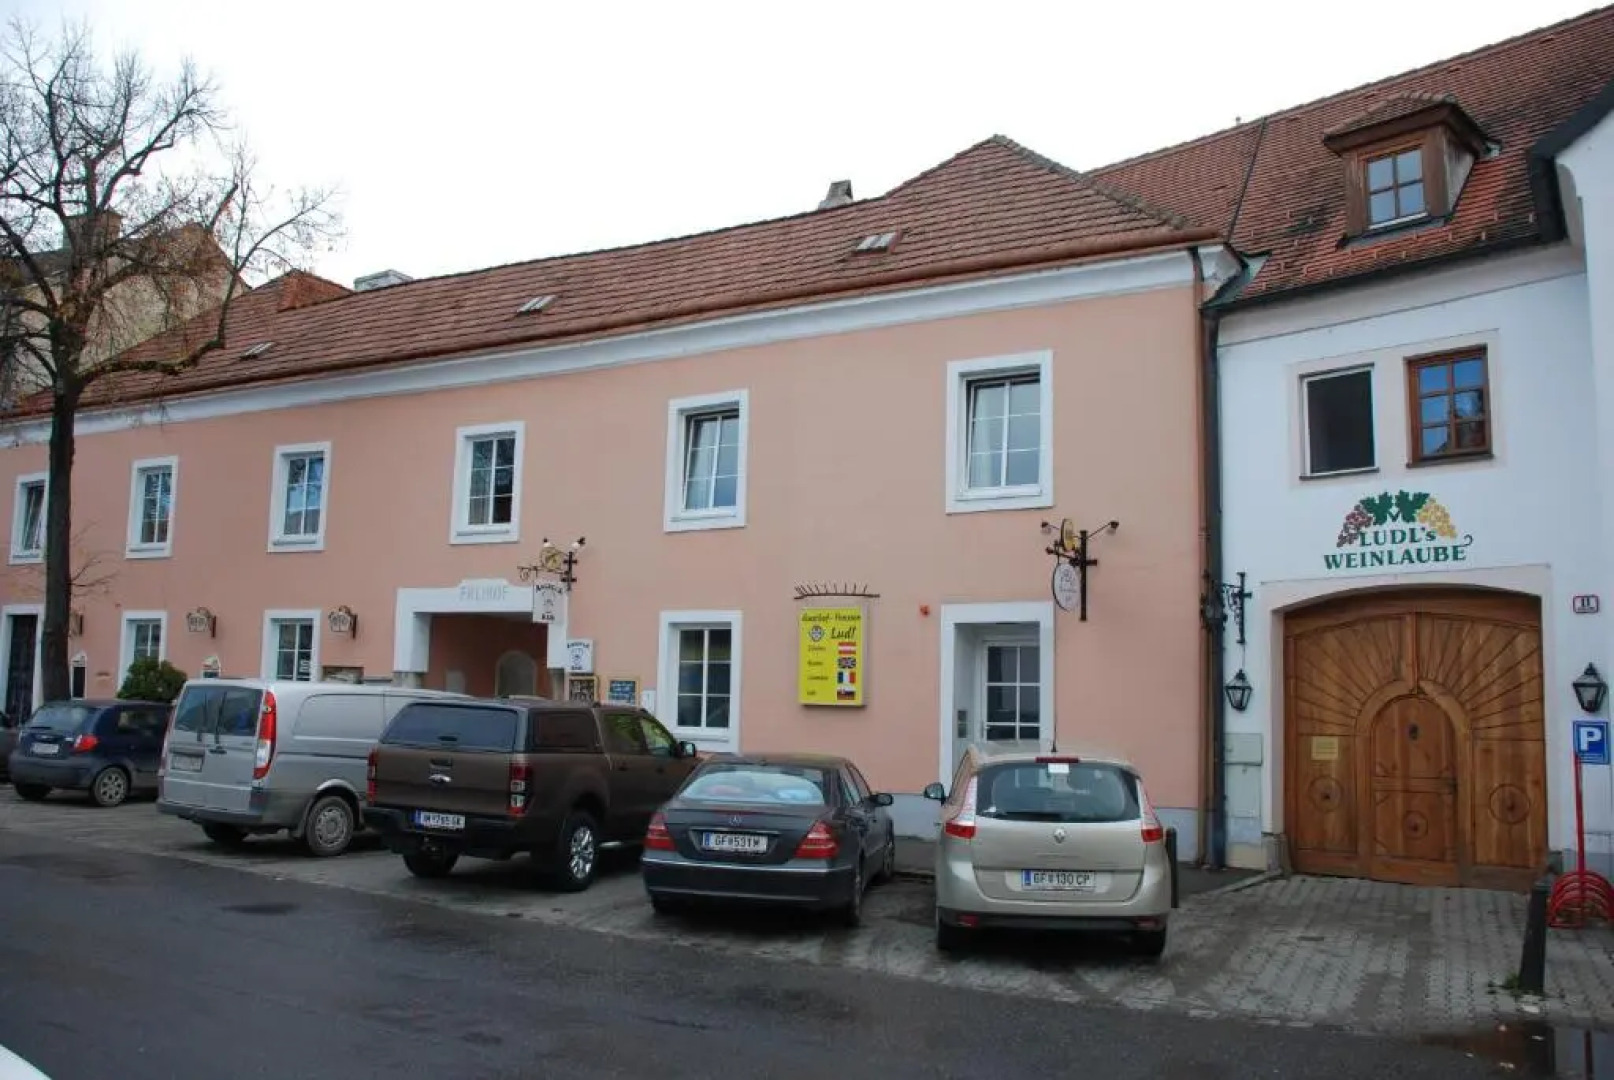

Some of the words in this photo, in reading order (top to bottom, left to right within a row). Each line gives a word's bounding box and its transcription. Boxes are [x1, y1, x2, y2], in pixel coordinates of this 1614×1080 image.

[1359, 527, 1436, 547] LUDL's
[1324, 540, 1471, 570] WEINLAUBE
[1579, 727, 1602, 751] P
